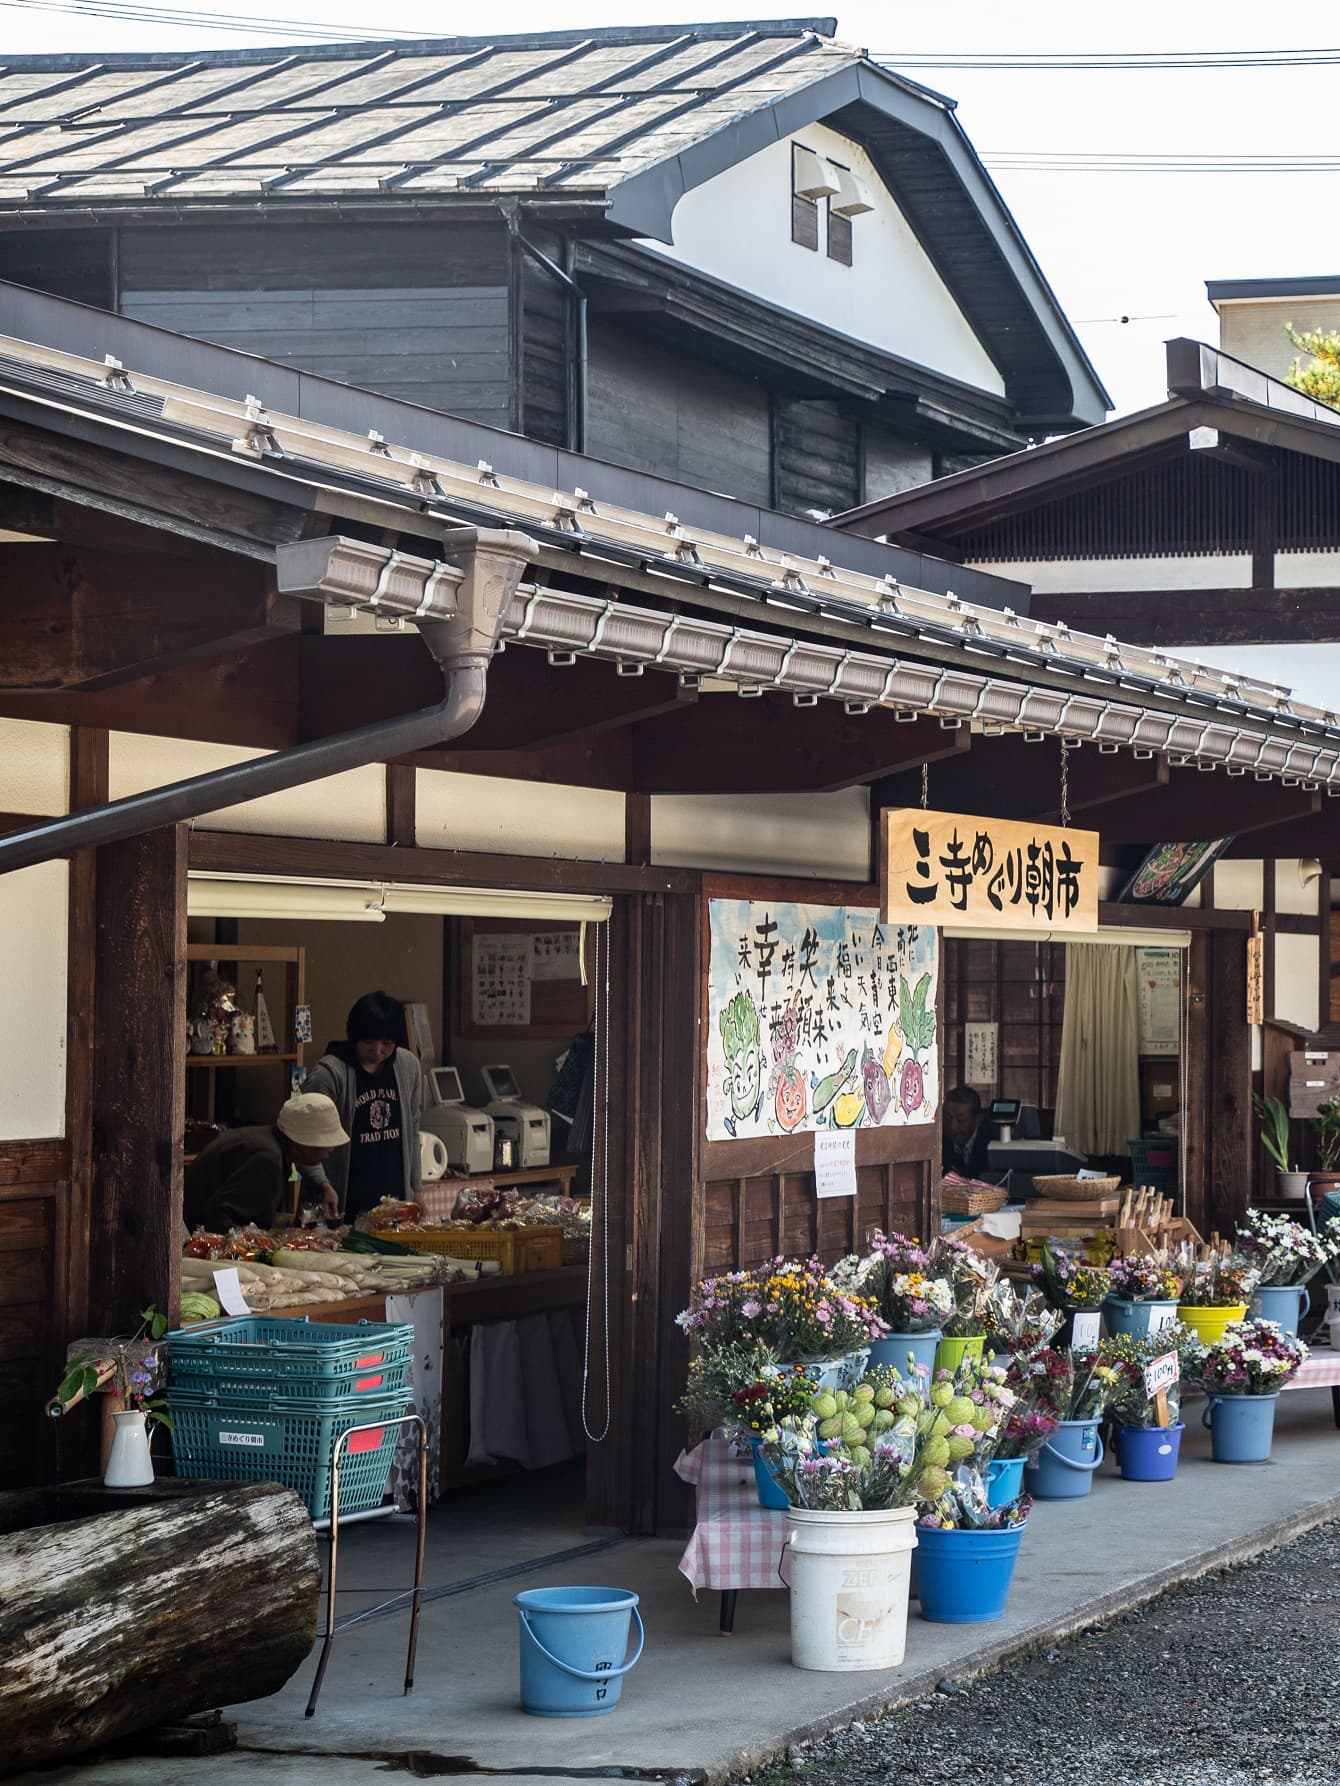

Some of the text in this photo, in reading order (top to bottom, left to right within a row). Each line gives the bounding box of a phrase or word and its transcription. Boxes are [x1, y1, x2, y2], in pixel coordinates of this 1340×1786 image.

[906, 826, 1085, 921] 三寺めぐり朝市
[360, 1128, 399, 1143] TRADTION
